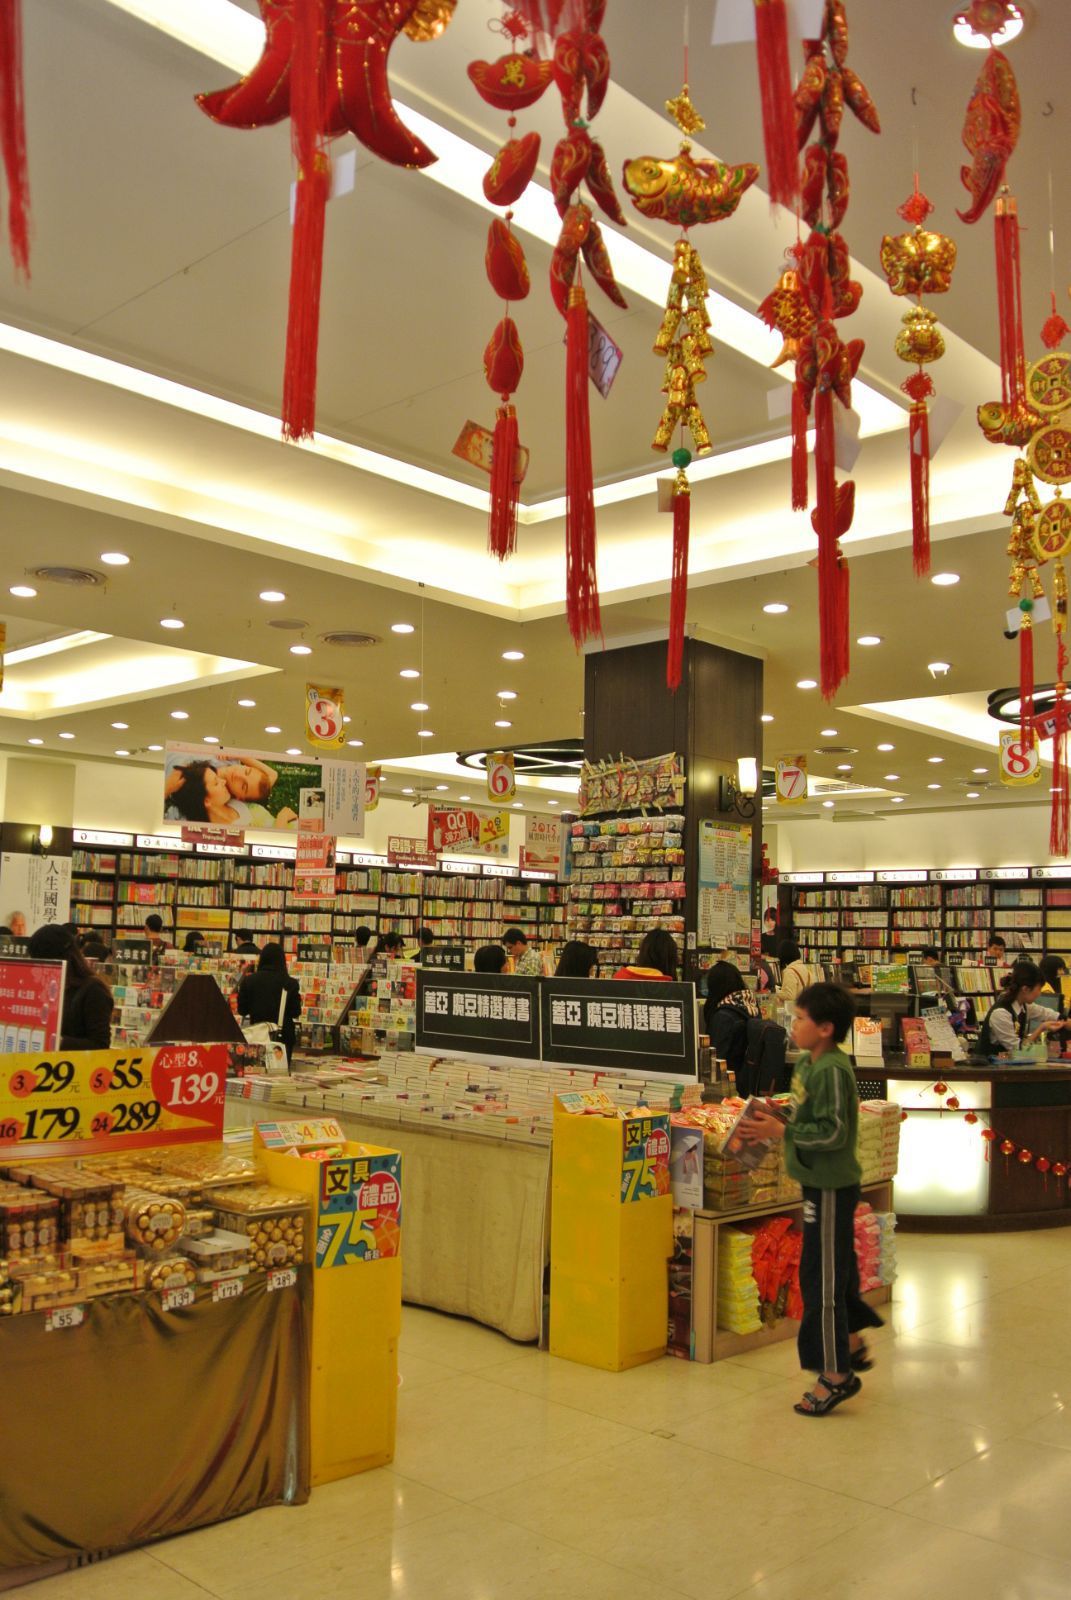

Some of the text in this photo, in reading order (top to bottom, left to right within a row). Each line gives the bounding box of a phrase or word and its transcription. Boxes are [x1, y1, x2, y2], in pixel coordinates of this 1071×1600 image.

[315, 701, 336, 737] 3
[1008, 743, 1031, 774] 8
[365, 779, 376, 804] 5
[492, 765, 508, 794] 6
[783, 770, 800, 797] 7
[447, 812, 467, 830] QQ
[43, 860, 59, 923] 人生國學
[426, 954, 461, 964] 經營管理
[424, 991, 530, 1022] 蓋亞 魔豆精選叢書
[551, 1000, 682, 1034] 蓋亞 魔豆精選叢書
[647, 1138, 667, 1156] 禮品
[623, 1158, 657, 1203] 75
[362, 1182, 397, 1207] 禮品
[319, 1208, 377, 1269] 75
[276, 1274, 292, 1287] 289
[173, 1292, 190, 1307] 139
[59, 1313, 73, 1326] 55
